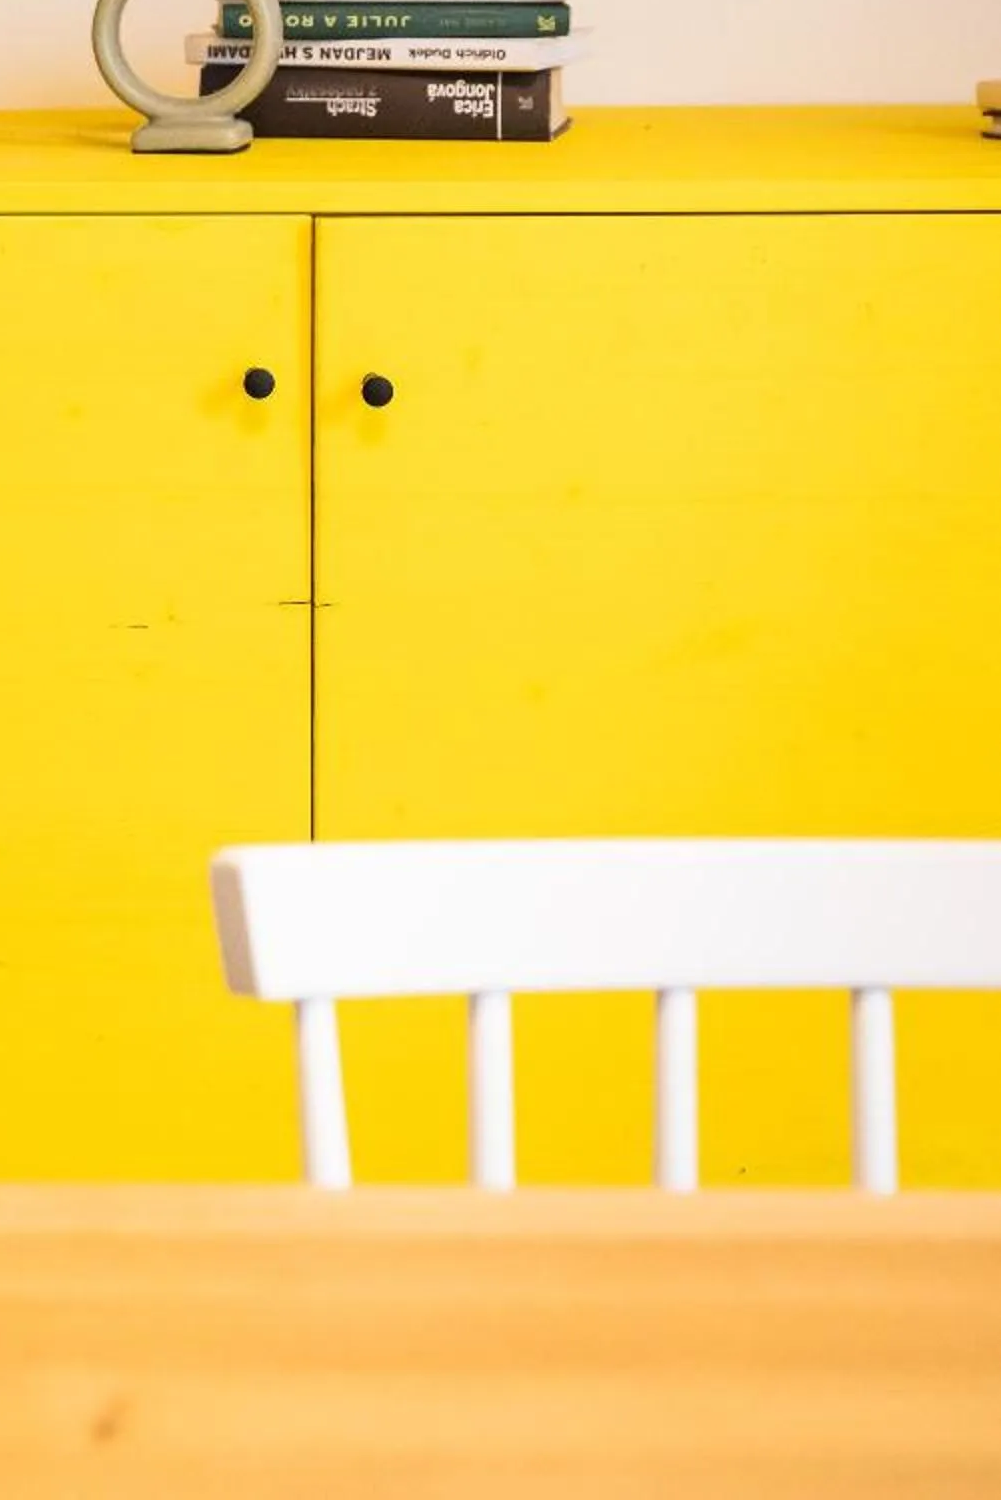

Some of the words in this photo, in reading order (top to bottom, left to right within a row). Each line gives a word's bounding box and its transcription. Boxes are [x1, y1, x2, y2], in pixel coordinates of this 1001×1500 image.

[238, 14, 315, 28] ROO
[324, 15, 339, 28] A
[346, 14, 412, 28] JULIE
[207, 43, 298, 60] HDAMI
[302, 46, 314, 59] S
[319, 47, 392, 61] MEJDAN
[408, 47, 452, 61] Dudek
[426, 79, 496, 102] Jongová
[326, 98, 378, 118] Strach
[453, 100, 494, 119] Erica
